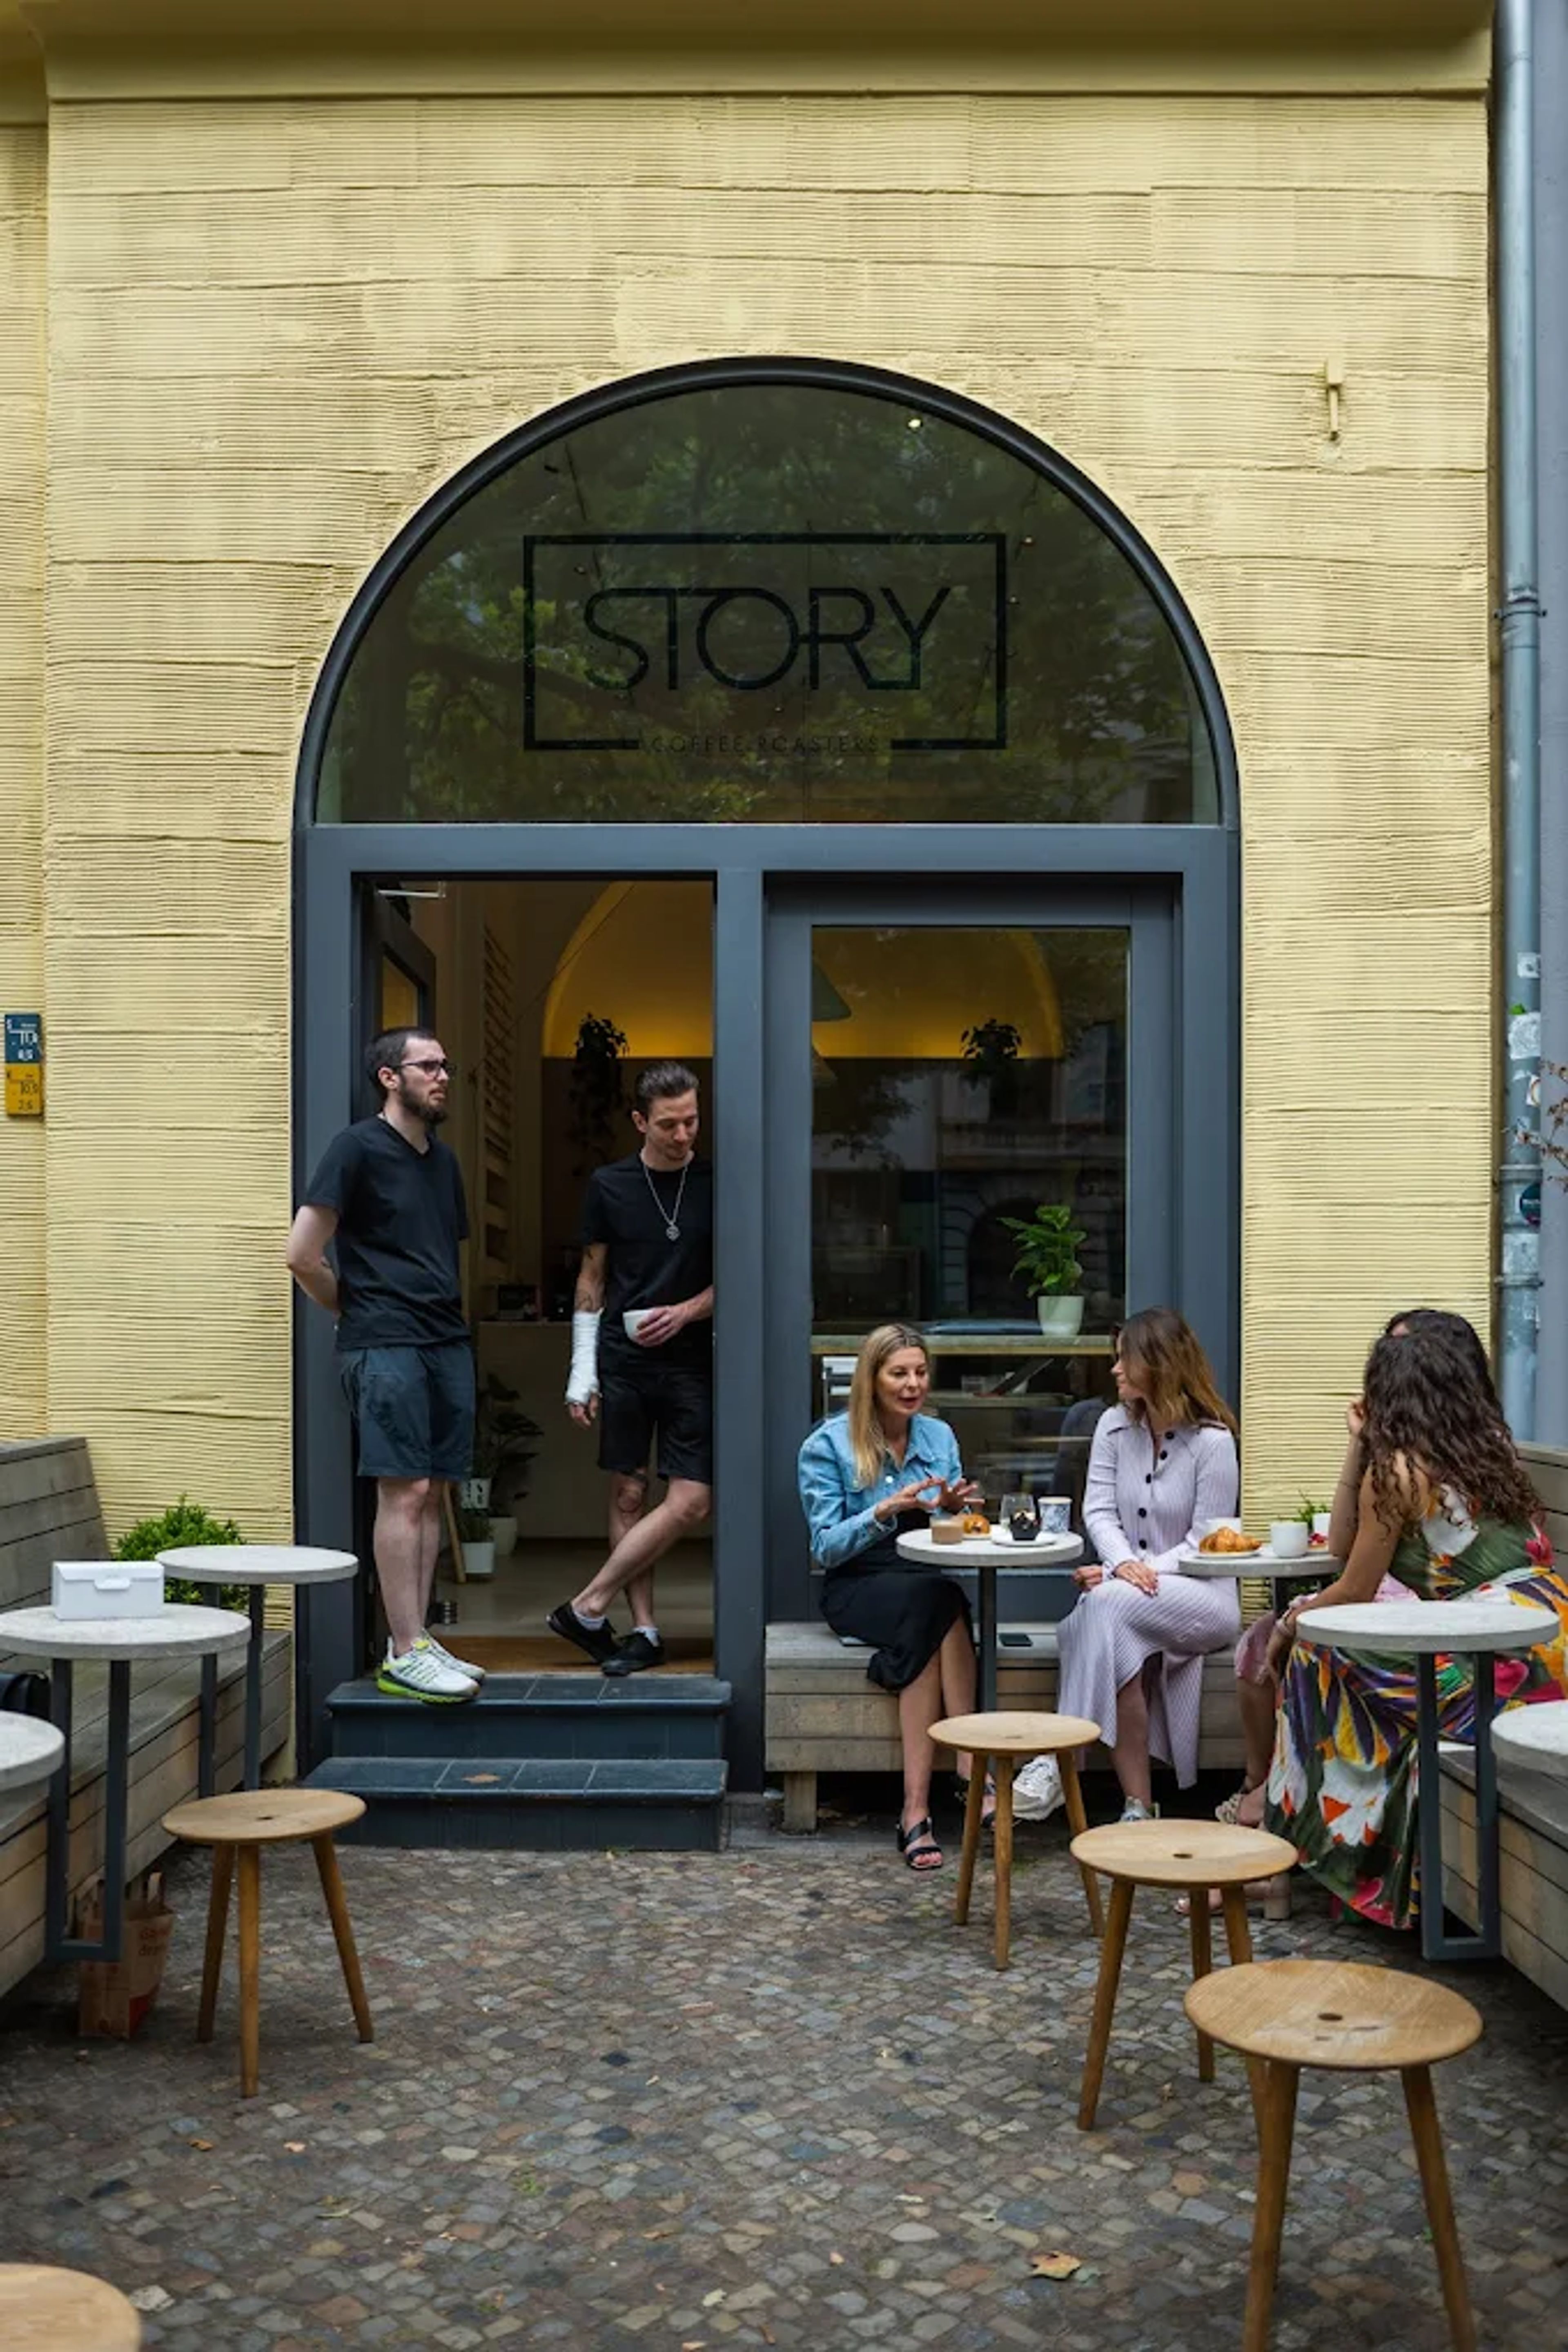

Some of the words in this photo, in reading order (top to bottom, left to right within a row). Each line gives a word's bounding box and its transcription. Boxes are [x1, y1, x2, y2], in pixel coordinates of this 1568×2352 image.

[584, 587, 951, 690] STORY
[652, 735, 744, 753] COFFEE
[757, 735, 878, 753] ROASTERS
